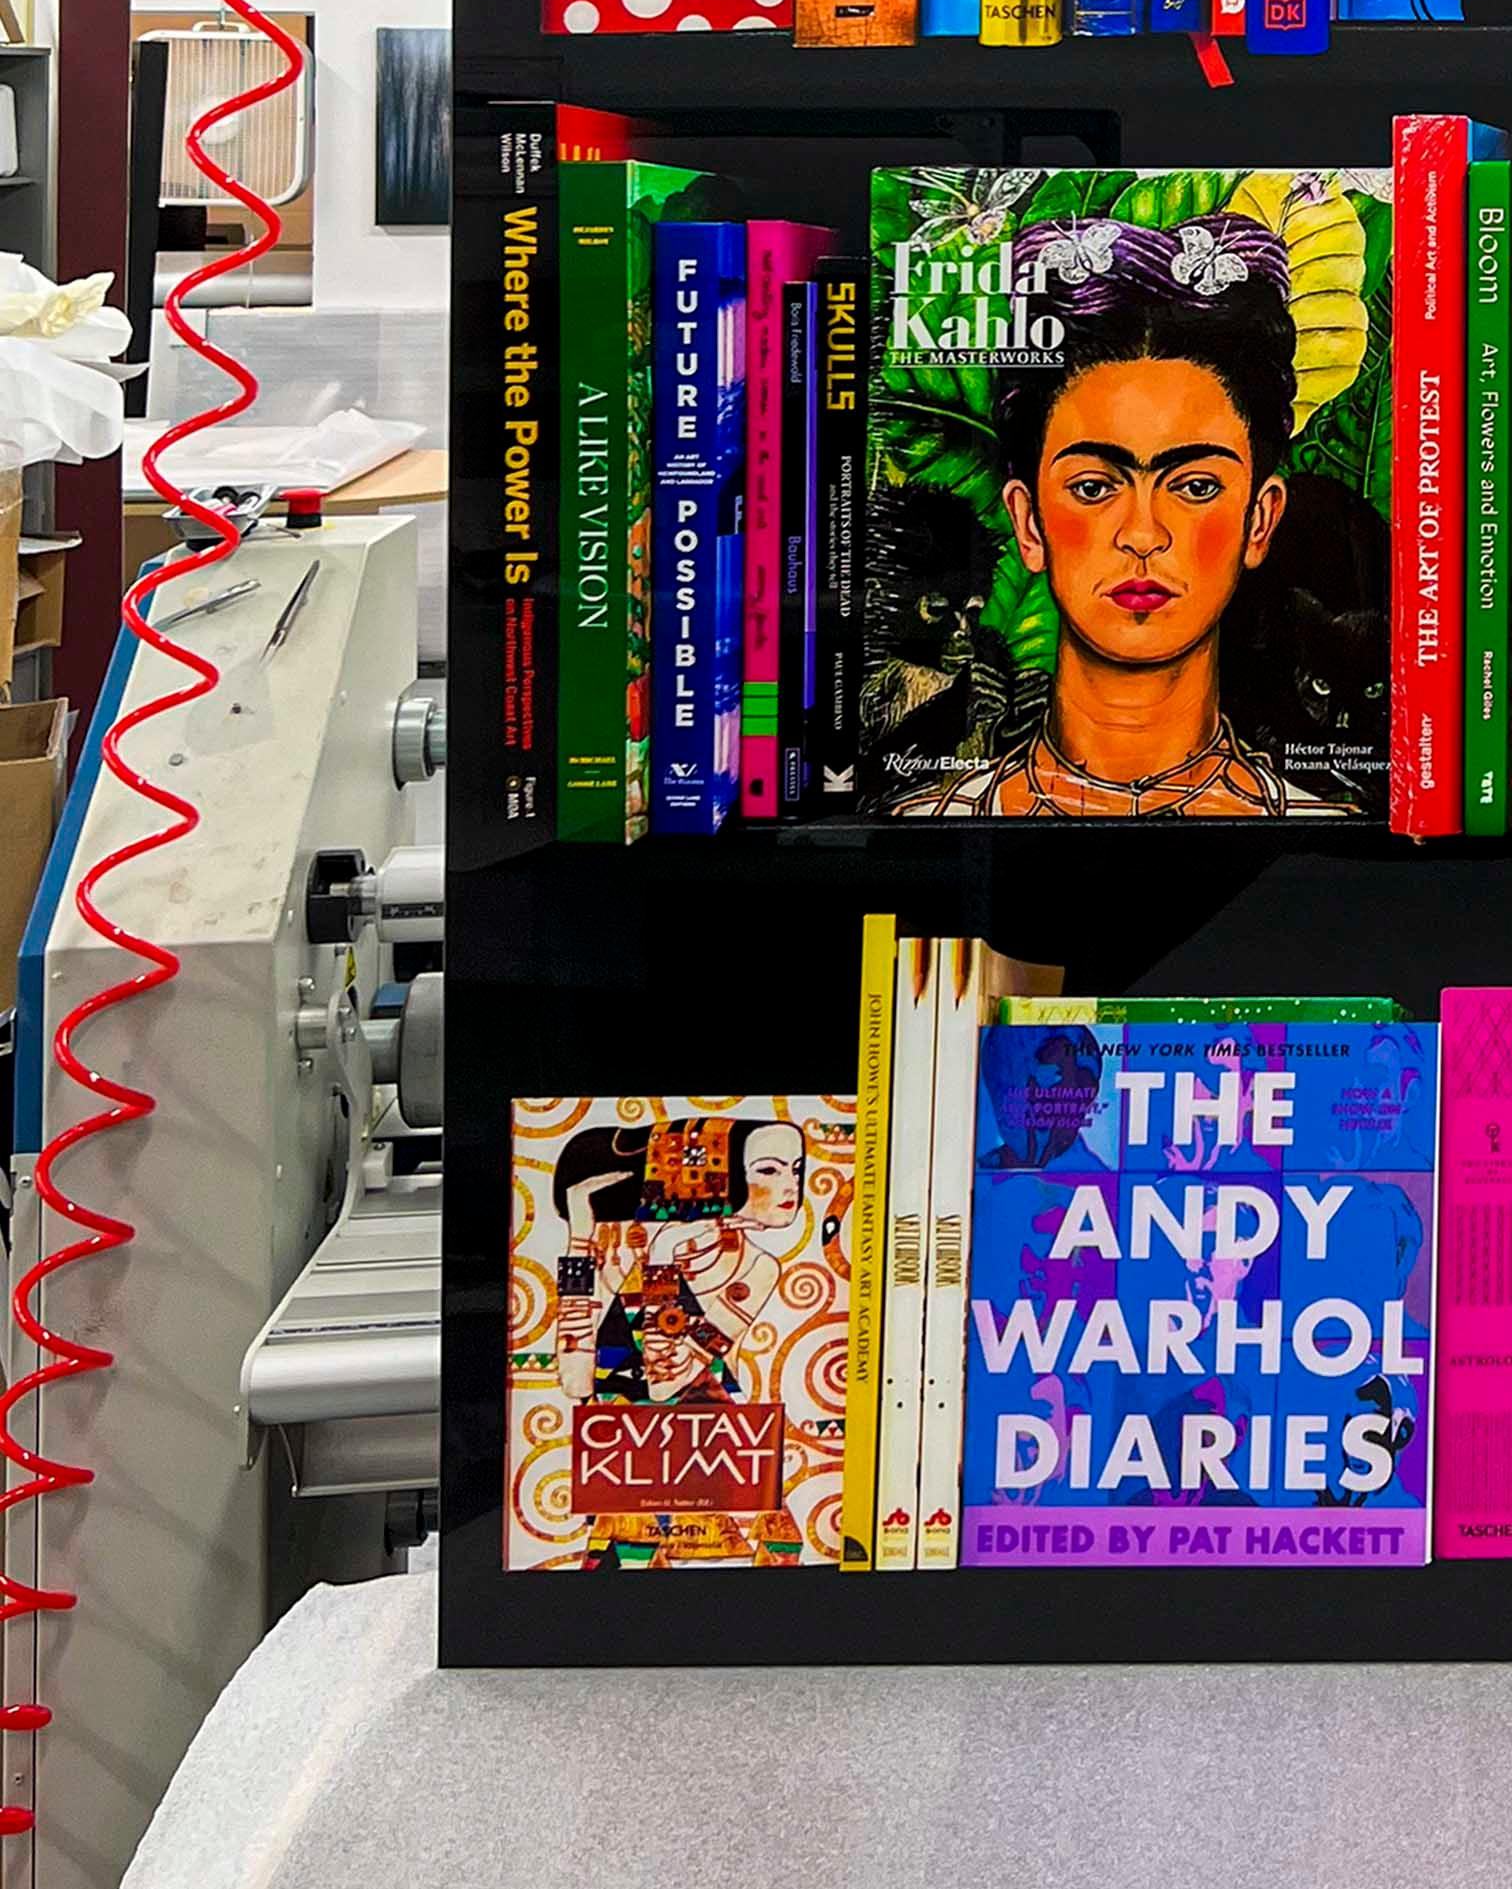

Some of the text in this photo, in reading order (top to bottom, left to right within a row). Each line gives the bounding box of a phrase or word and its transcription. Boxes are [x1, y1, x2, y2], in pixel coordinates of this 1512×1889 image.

[985, 4, 1055, 19] TASCHEN
[890, 242, 1048, 294] Frida
[826, 283, 855, 410] SKULLS
[890, 296, 1065, 350] Kahlo
[891, 351, 1064, 363] THE MASTERWORKS
[504, 207, 538, 585] Where the Power Is
[674, 259, 698, 727] FUTURE POSSIBLE
[1418, 371, 1440, 667] THE ART OF PROTEST
[788, 536, 803, 594] Bauhaus
[1420, 713, 1433, 790] gestalten
[1100, 1043, 1141, 1057] NEW
[1150, 1043, 1194, 1057] YORK
[1205, 1043, 1250, 1057] TIMES
[1257, 1043, 1350, 1057] BESTSELLER
[1116, 1072, 1296, 1146] THE
[1049, 1185, 1354, 1260] ANDY
[970, 1298, 1424, 1376] WARHOL
[582, 1450, 775, 1486] KLIMT
[995, 1414, 1393, 1491] DIARIES
[977, 1526, 1094, 1554] EDITED
[1109, 1526, 1156, 1554] BY
[1170, 1526, 1233, 1554] PAT
[1246, 1526, 1405, 1554] HACKETT
